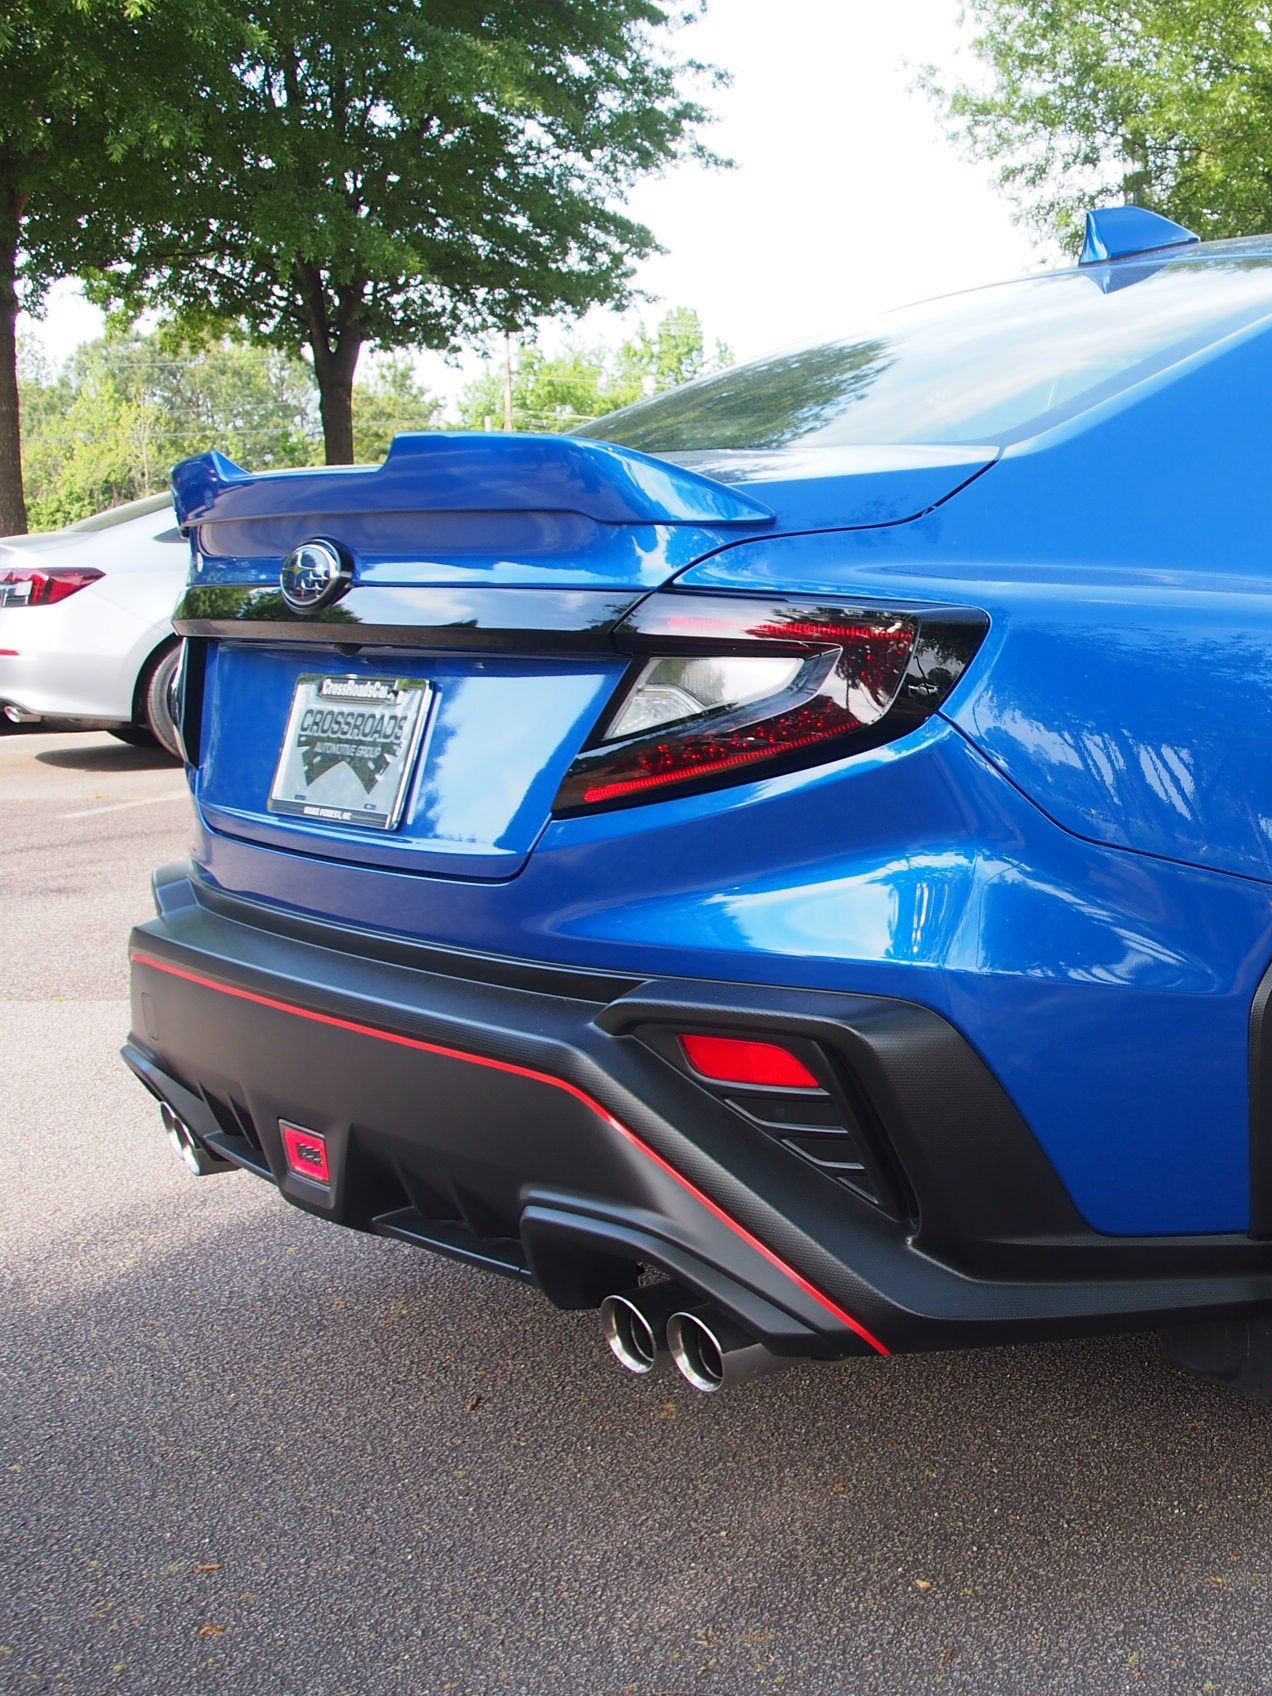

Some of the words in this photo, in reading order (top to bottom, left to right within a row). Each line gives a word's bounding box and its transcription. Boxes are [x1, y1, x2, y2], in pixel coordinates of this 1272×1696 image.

[301, 709, 408, 741] CROSSROADS
[314, 742, 356, 757] AUTOMOTIVE
[356, 745, 381, 758] GROUP
